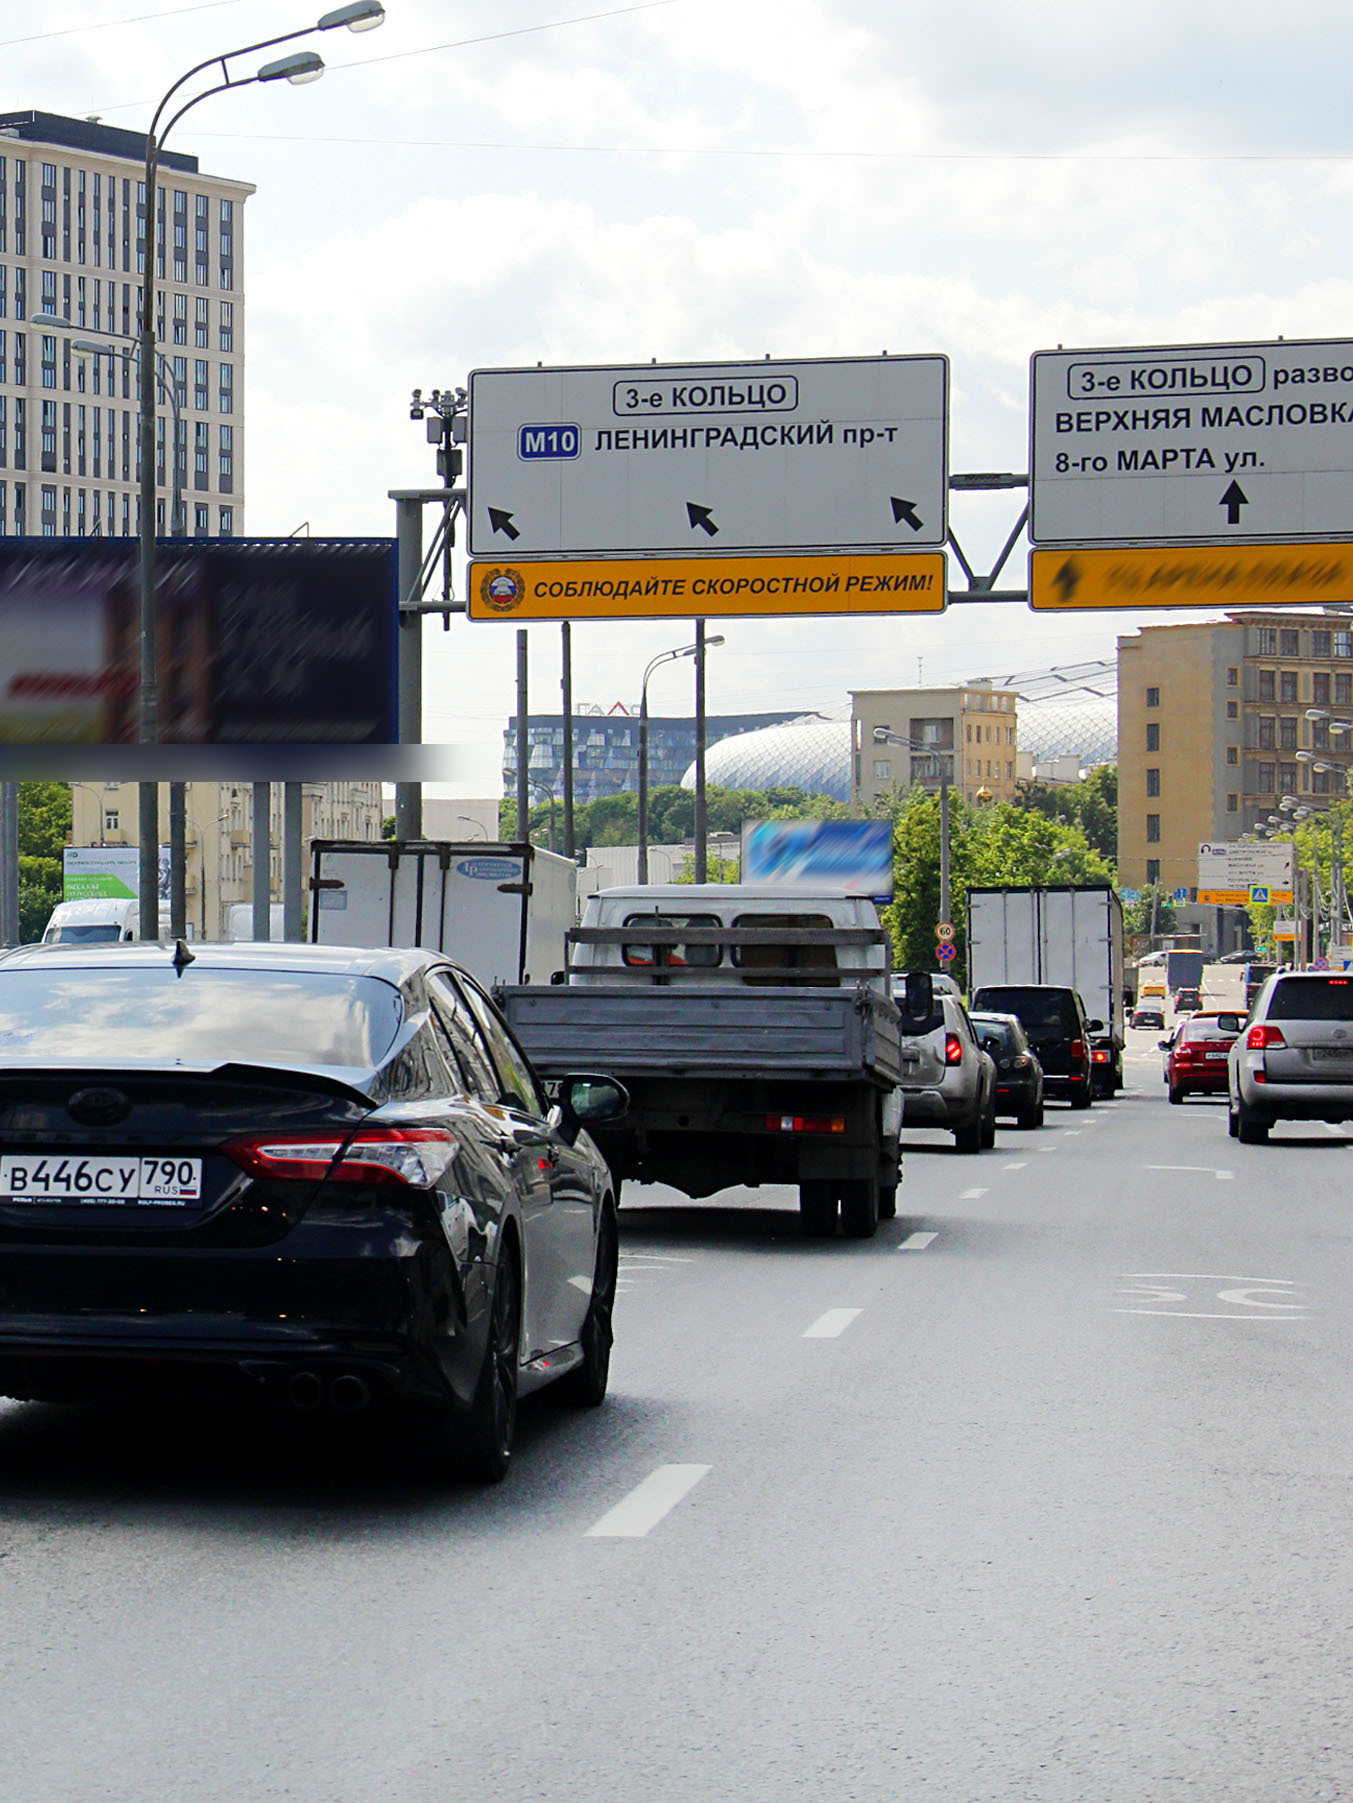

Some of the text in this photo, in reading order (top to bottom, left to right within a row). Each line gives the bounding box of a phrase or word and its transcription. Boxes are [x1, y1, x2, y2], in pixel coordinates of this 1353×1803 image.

[1080, 371, 1121, 392] 3-е
[1130, 364, 1253, 391] КОЛЬЦО
[625, 383, 787, 410] 3-е КОЛЬЦО
[1055, 407, 1192, 433] ВЕРХНЯЯ
[524, 430, 576, 454] М10
[594, 420, 899, 452] ЛЕНИНГРАДСКИЙ пр-т
[1055, 447, 1265, 474] 8-го МАРТА ул.
[533, 572, 934, 600] СОБЛЮДАЙТЕ СКОРОСТНОЙ РЕЖИМ!
[940, 927, 951, 935] 60
[10, 1160, 194, 1192] В446СУ 790
[154, 1185, 179, 1195] RUS
